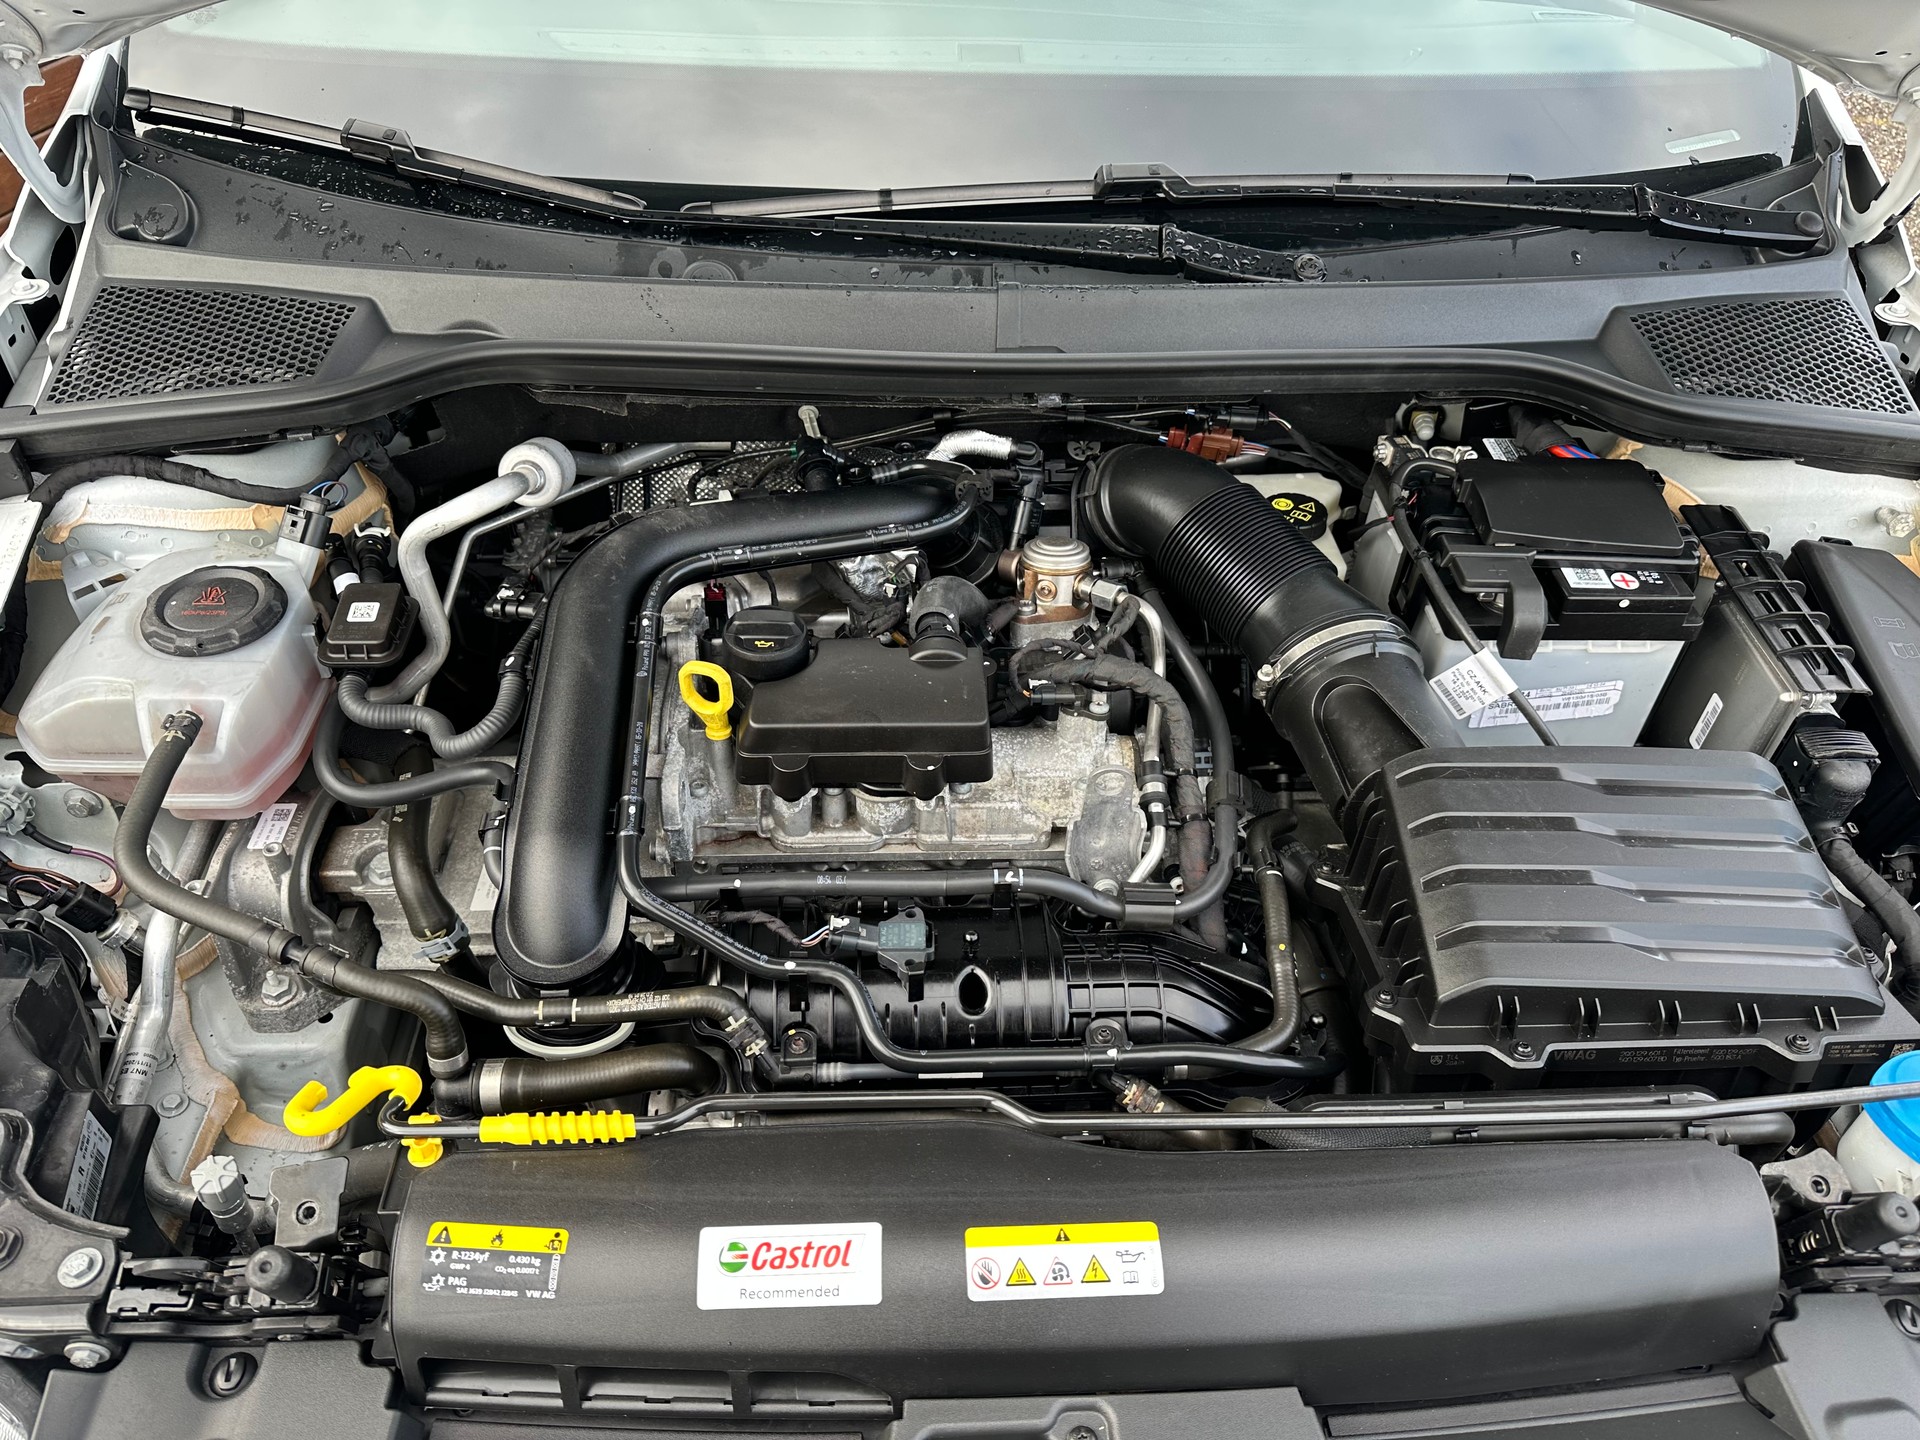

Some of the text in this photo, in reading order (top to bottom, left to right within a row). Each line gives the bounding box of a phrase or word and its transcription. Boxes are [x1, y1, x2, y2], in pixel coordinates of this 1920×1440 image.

[1466, 669, 1489, 696] CZ-AKK
[452, 1251, 490, 1263] R-1234yf
[509, 1255, 541, 1267] 0.430 kg
[751, 1240, 852, 1271] Castrol
[448, 1277, 467, 1286] PAG
[526, 1290, 556, 1299] VW AG
[739, 1285, 840, 1300] Recommended
